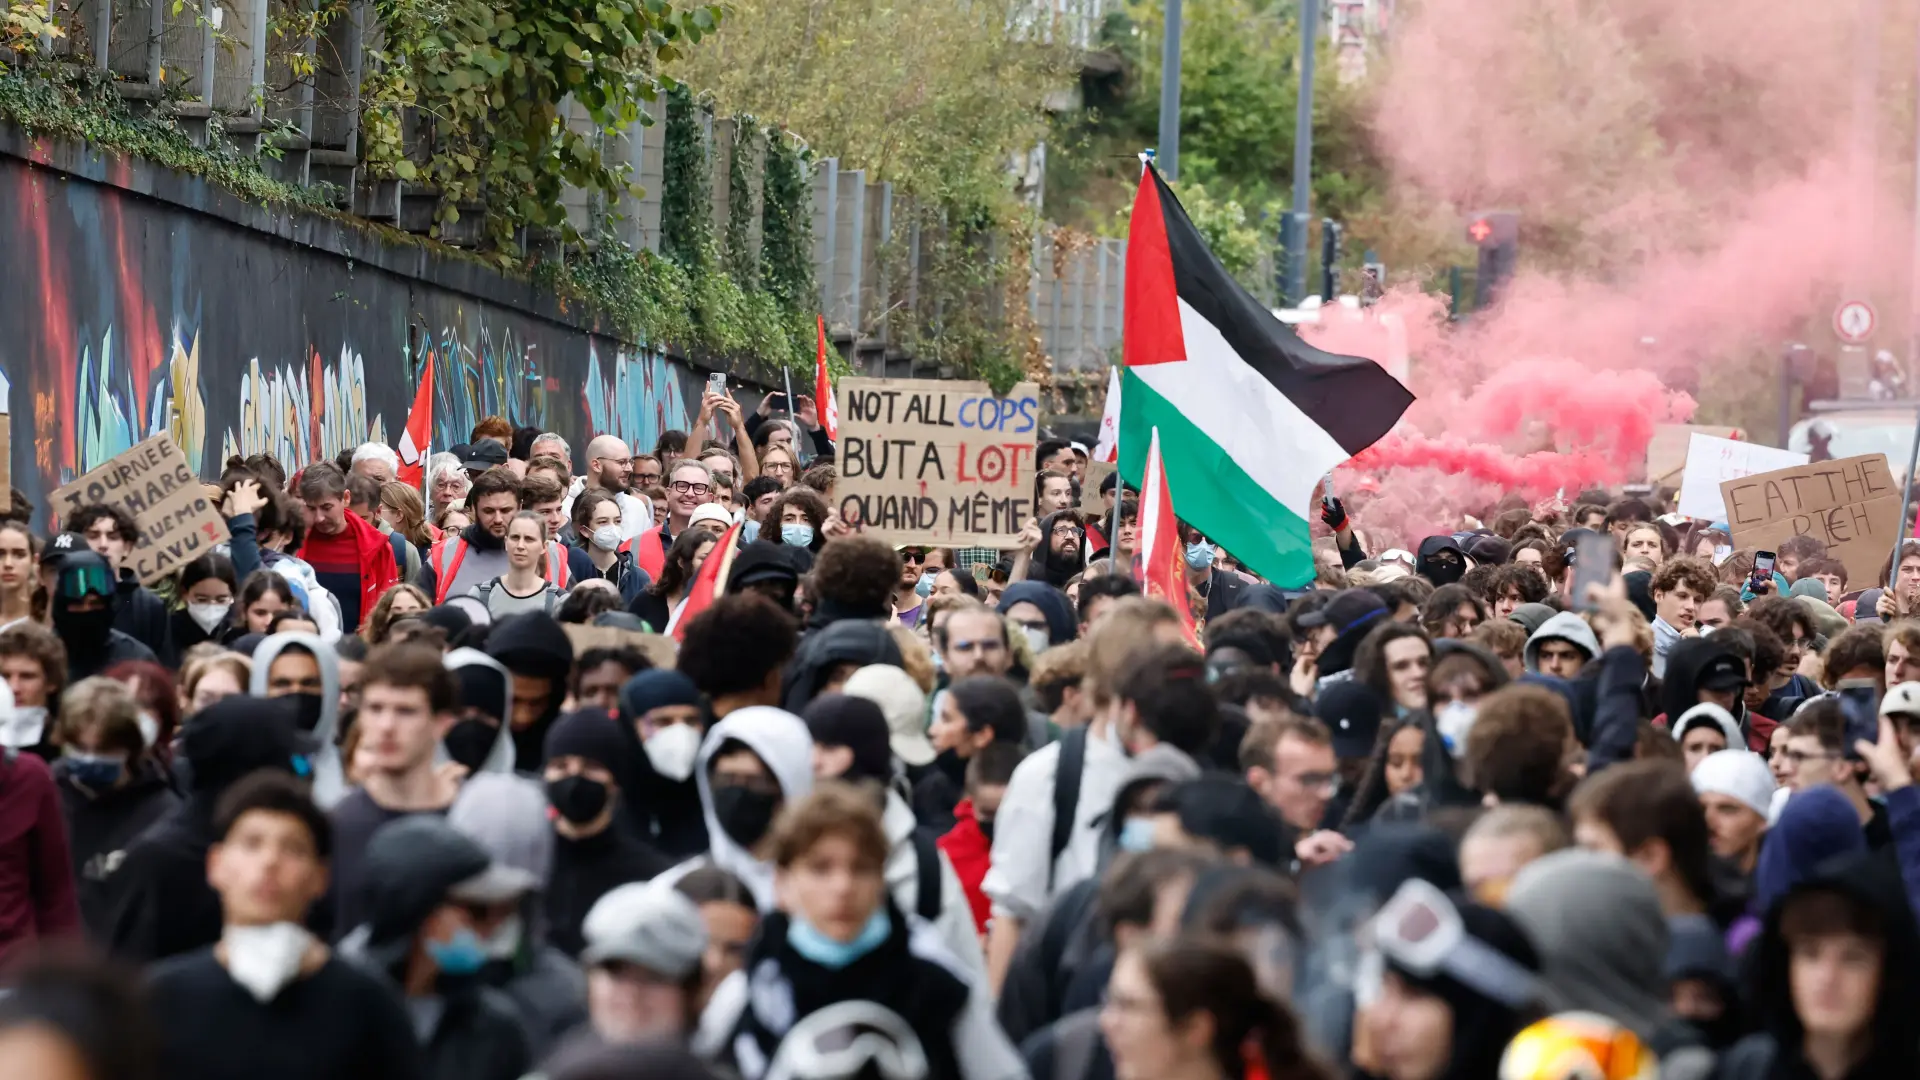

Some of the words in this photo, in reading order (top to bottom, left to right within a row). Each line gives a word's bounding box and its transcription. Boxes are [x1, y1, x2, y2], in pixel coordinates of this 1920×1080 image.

[849, 390, 901, 424] NOT
[903, 394, 954, 427] ALL
[958, 397, 1038, 433] COPS
[64, 439, 173, 509] TOURNEE
[843, 437, 916, 481] BUT
[916, 440, 945, 480] A
[955, 441, 1034, 488] LOT
[110, 463, 191, 517] HARG
[840, 494, 939, 534] QUAND
[947, 490, 1030, 534] MÊME
[1729, 475, 1811, 524] EAT
[1813, 458, 1887, 502] THE
